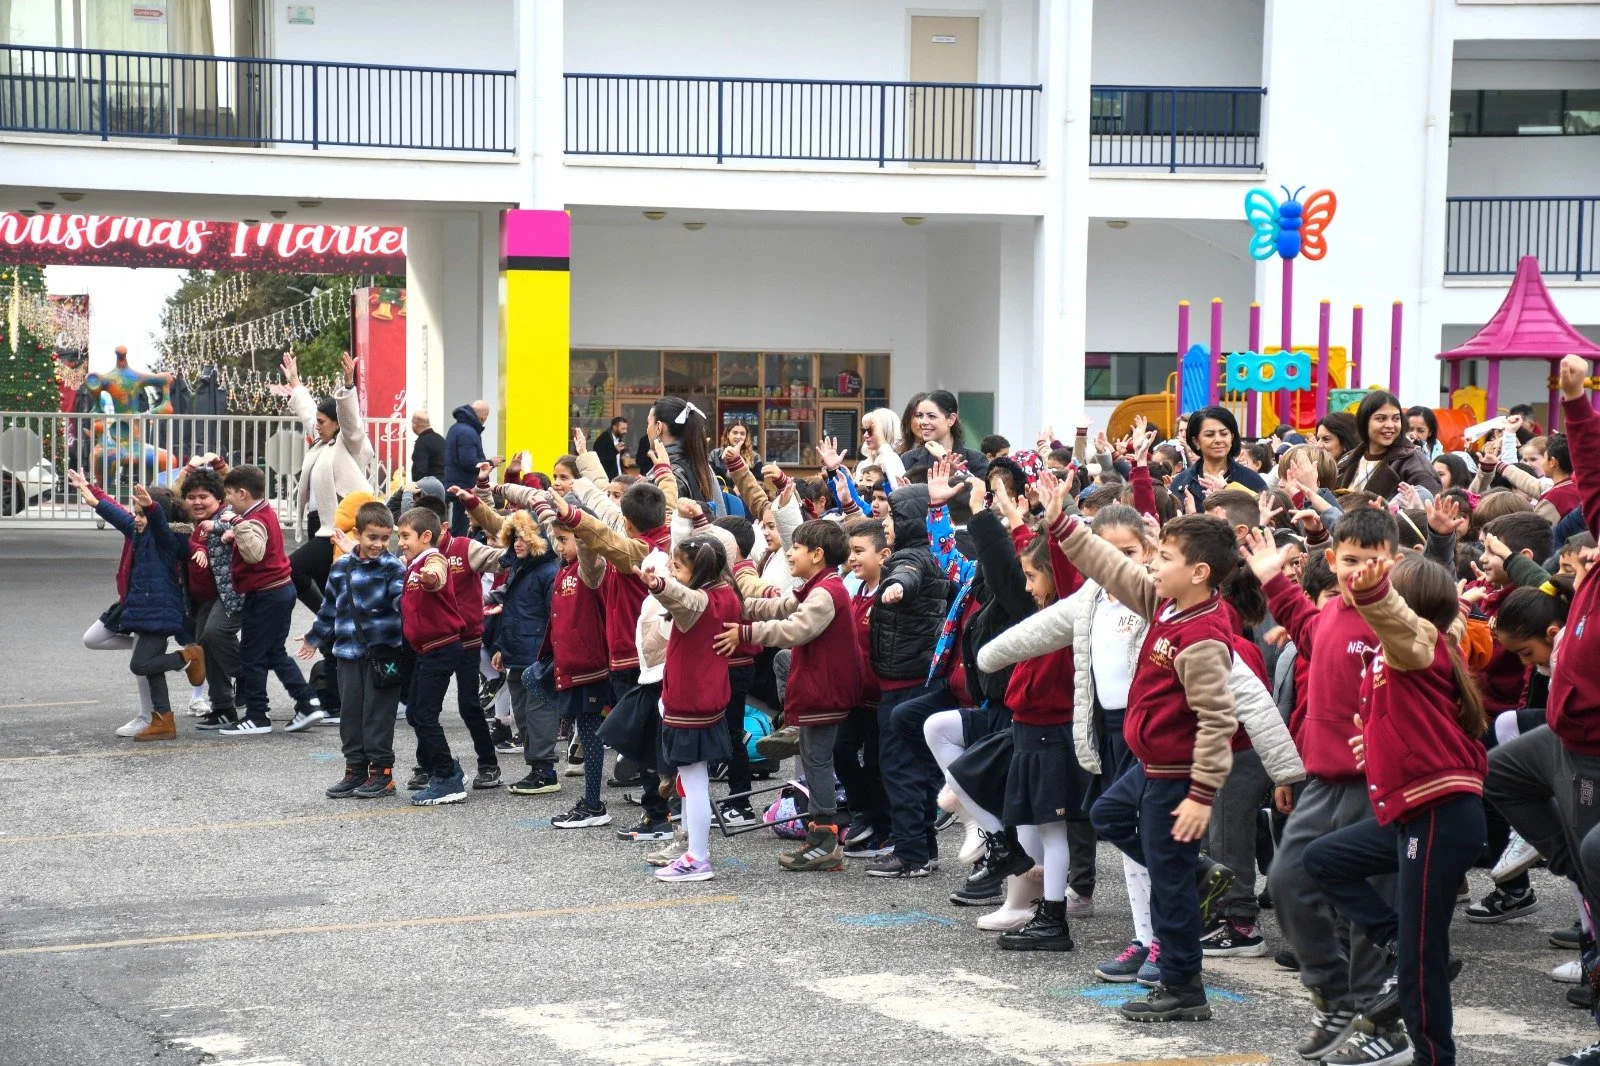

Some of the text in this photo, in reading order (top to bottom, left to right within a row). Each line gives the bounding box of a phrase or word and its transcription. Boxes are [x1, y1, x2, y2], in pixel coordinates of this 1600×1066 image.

[230, 221, 408, 258] Marke
[561, 575, 578, 590] NEC
[1153, 636, 1178, 660] NEC
[1580, 779, 1594, 806] NEC
